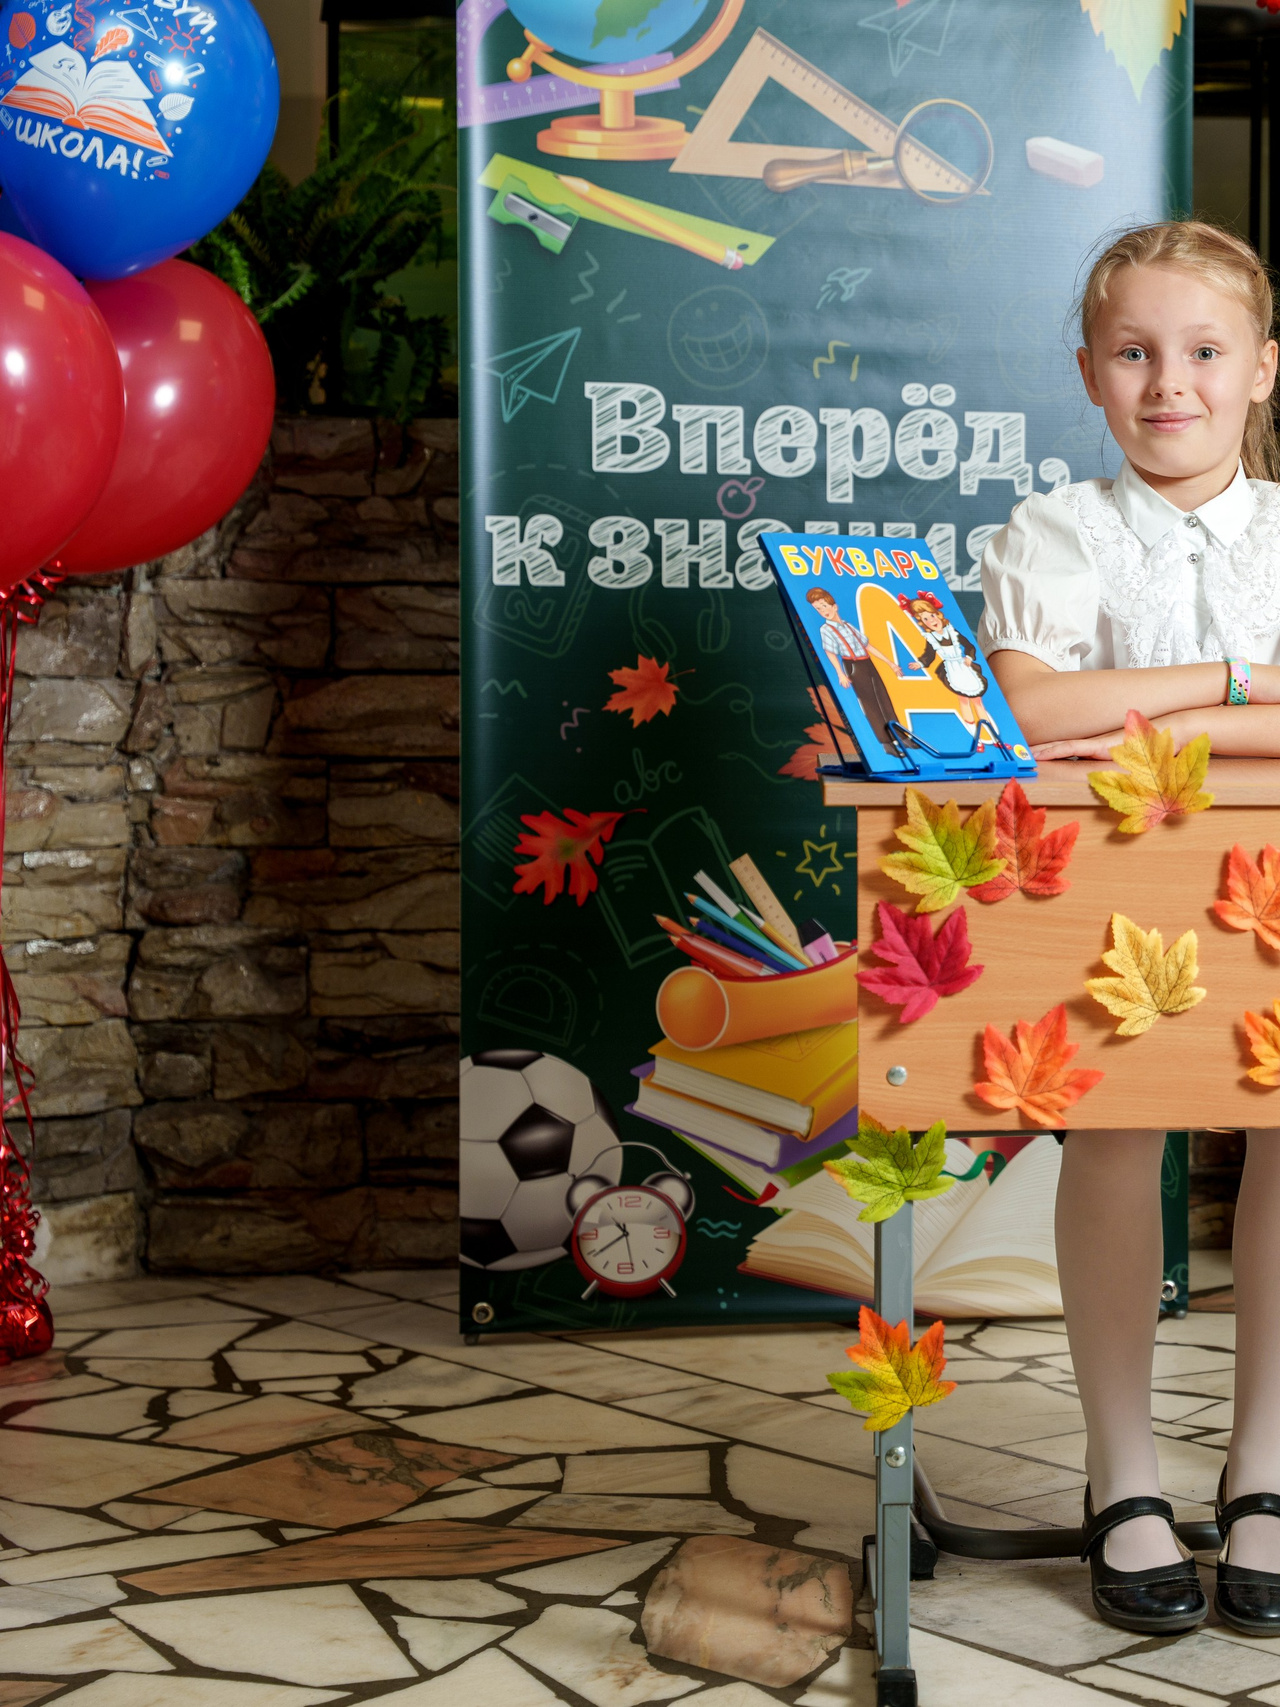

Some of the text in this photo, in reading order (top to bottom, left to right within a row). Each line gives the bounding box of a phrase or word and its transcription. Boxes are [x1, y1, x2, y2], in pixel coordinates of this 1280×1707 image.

[15, 115, 144, 180] ШКОЛА!
[584, 381, 1071, 504] Вперёд,
[484, 513, 566, 588] к
[778, 544, 940, 581] БУКВАРЬ
[855, 582, 1000, 745] А
[614, 748, 683, 804] abc
[617, 1196, 643, 1208] 12
